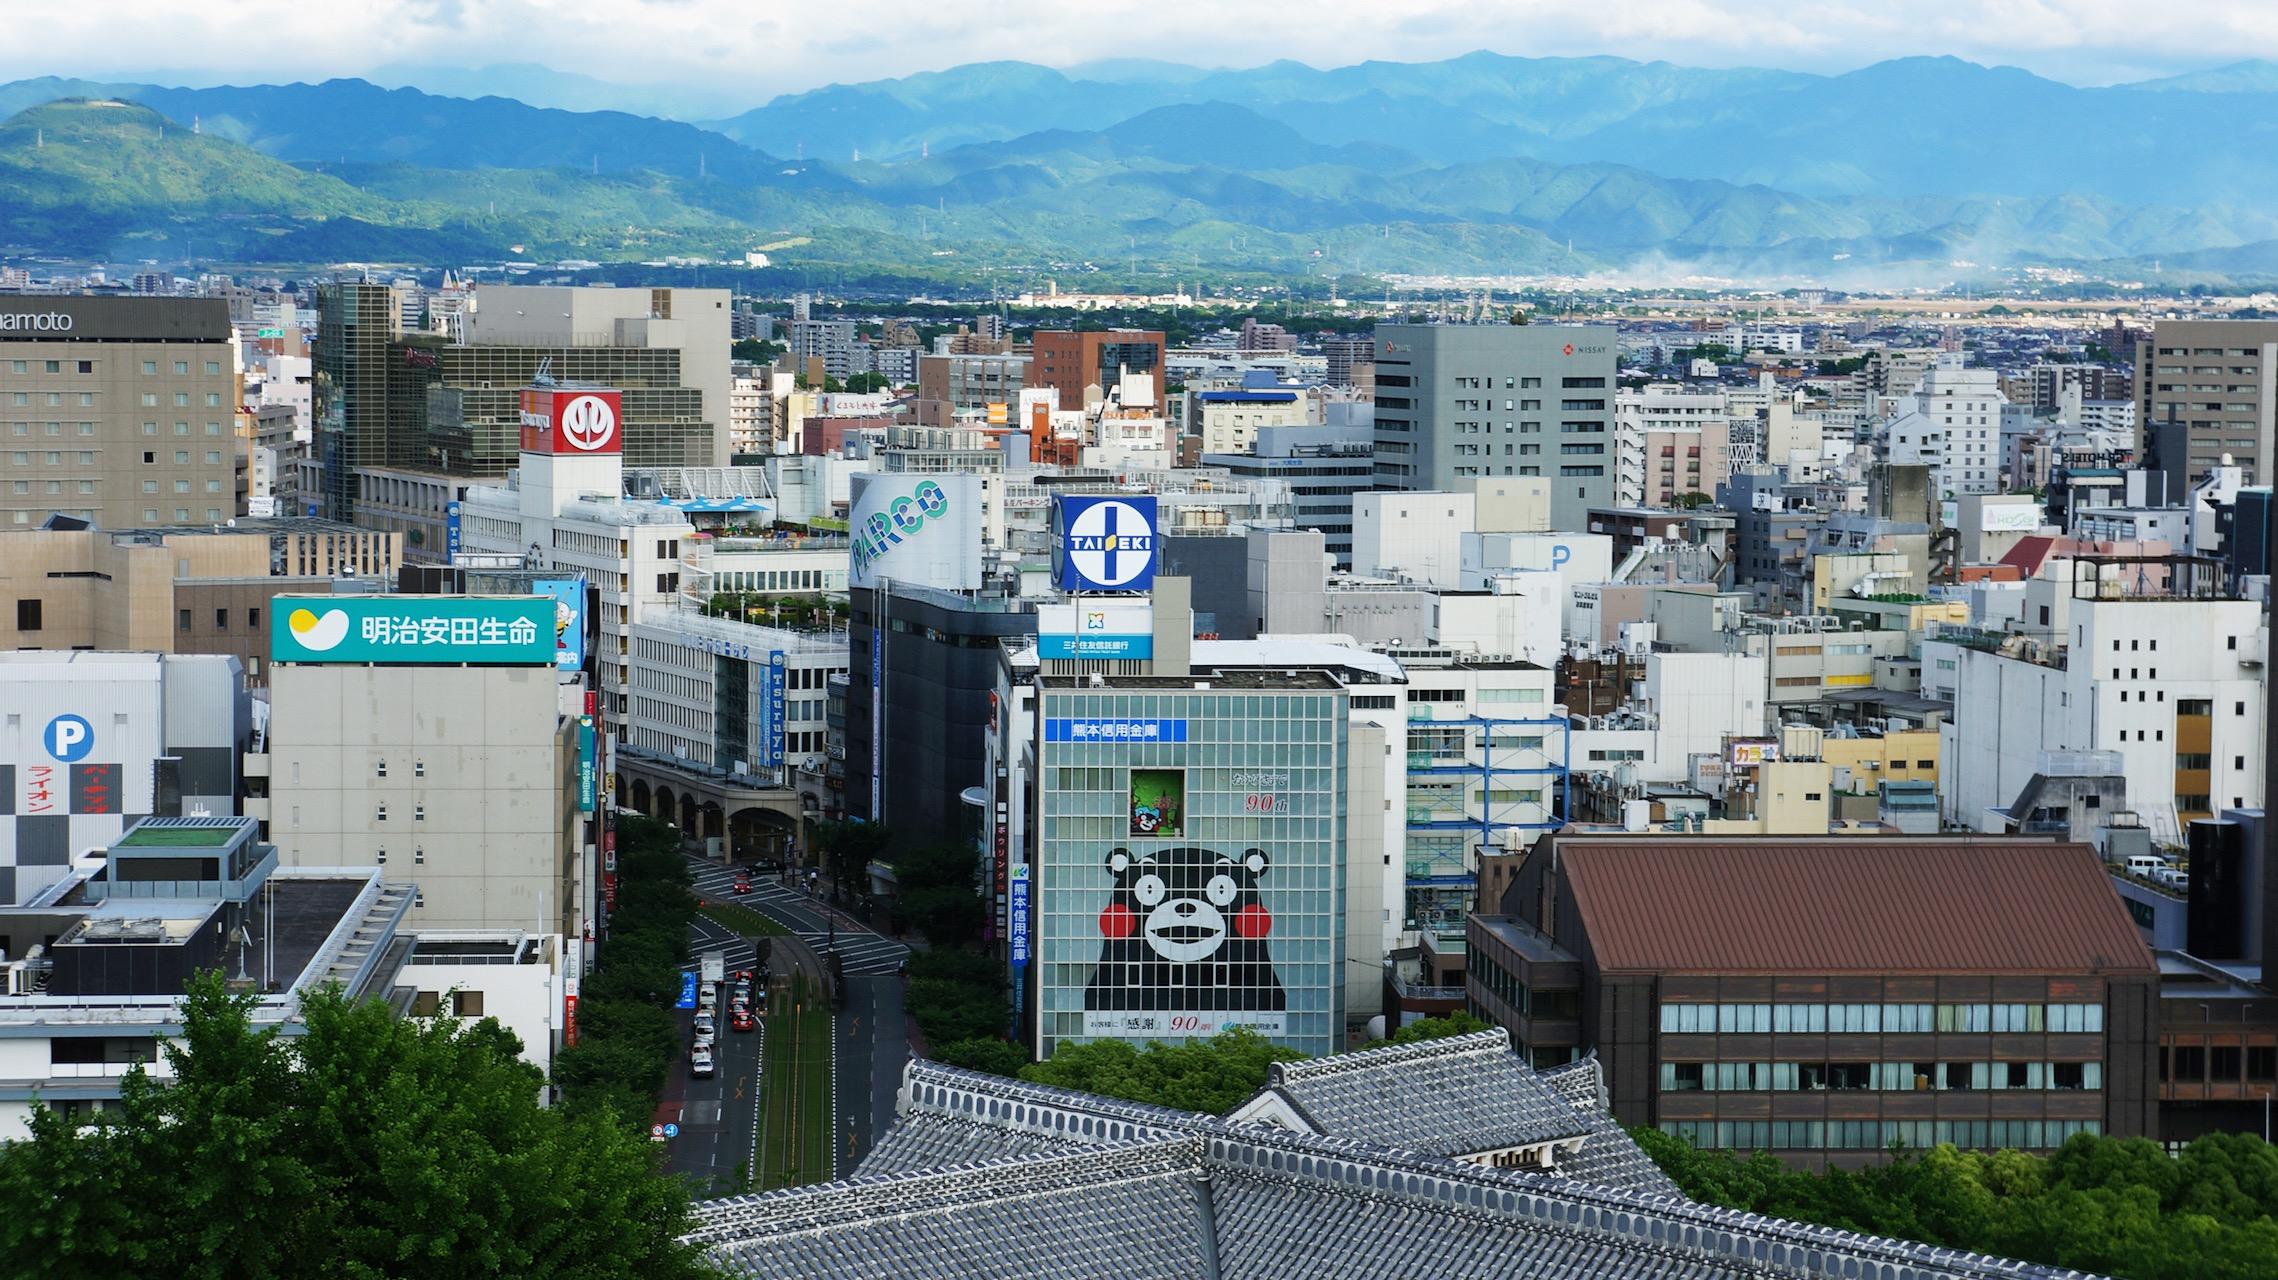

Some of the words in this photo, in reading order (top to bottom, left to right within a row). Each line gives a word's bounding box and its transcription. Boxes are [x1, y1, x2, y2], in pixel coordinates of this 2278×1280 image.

[0, 311, 72, 331] amoto
[1577, 346, 1606, 354] NISSAY
[851, 480, 948, 581] PARCO
[1552, 545, 1571, 572] P
[362, 616, 538, 646] 明治安田生命
[772, 674, 783, 760] Tsuruya
[1072, 723, 1158, 738] 熊本信用金庫
[56, 720, 86, 756] P
[1736, 746, 1781, 762] カラオ
[28, 765, 54, 813] ライオン
[1232, 773, 1288, 787] おかげさまで
[1246, 793, 1288, 813] 90th
[997, 825, 1006, 880] ボウリング
[1013, 883, 1027, 961] 熊本信用金庫
